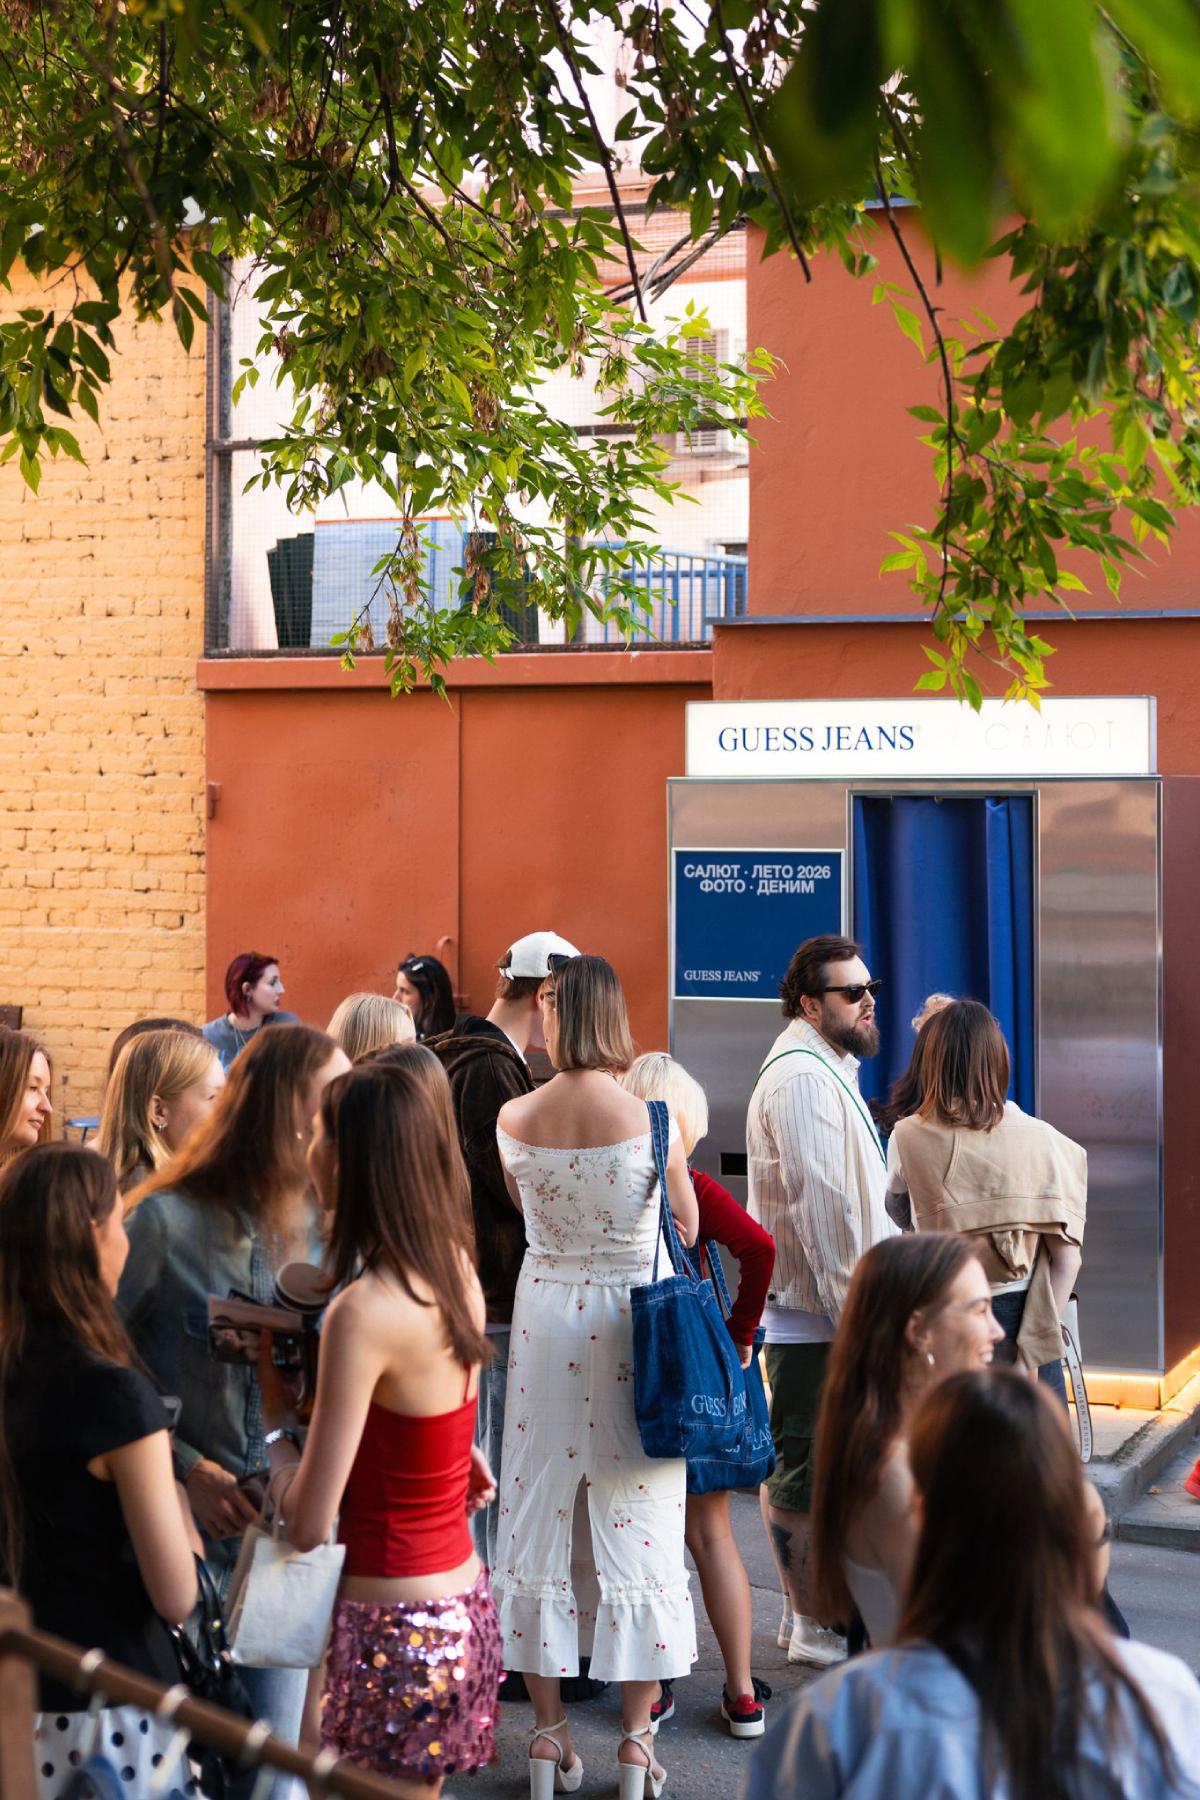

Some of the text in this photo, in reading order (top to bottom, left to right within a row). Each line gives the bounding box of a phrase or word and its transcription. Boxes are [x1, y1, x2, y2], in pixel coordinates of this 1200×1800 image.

[718, 725, 914, 751] GUESS JEANS
[684, 864, 830, 879] САЛЮТ ЛЕТО 2026
[700, 879, 814, 896] ФОТО ДЕНИМ
[684, 970, 759, 982] GUESS JEANS
[691, 1395, 726, 1417] GUESS
